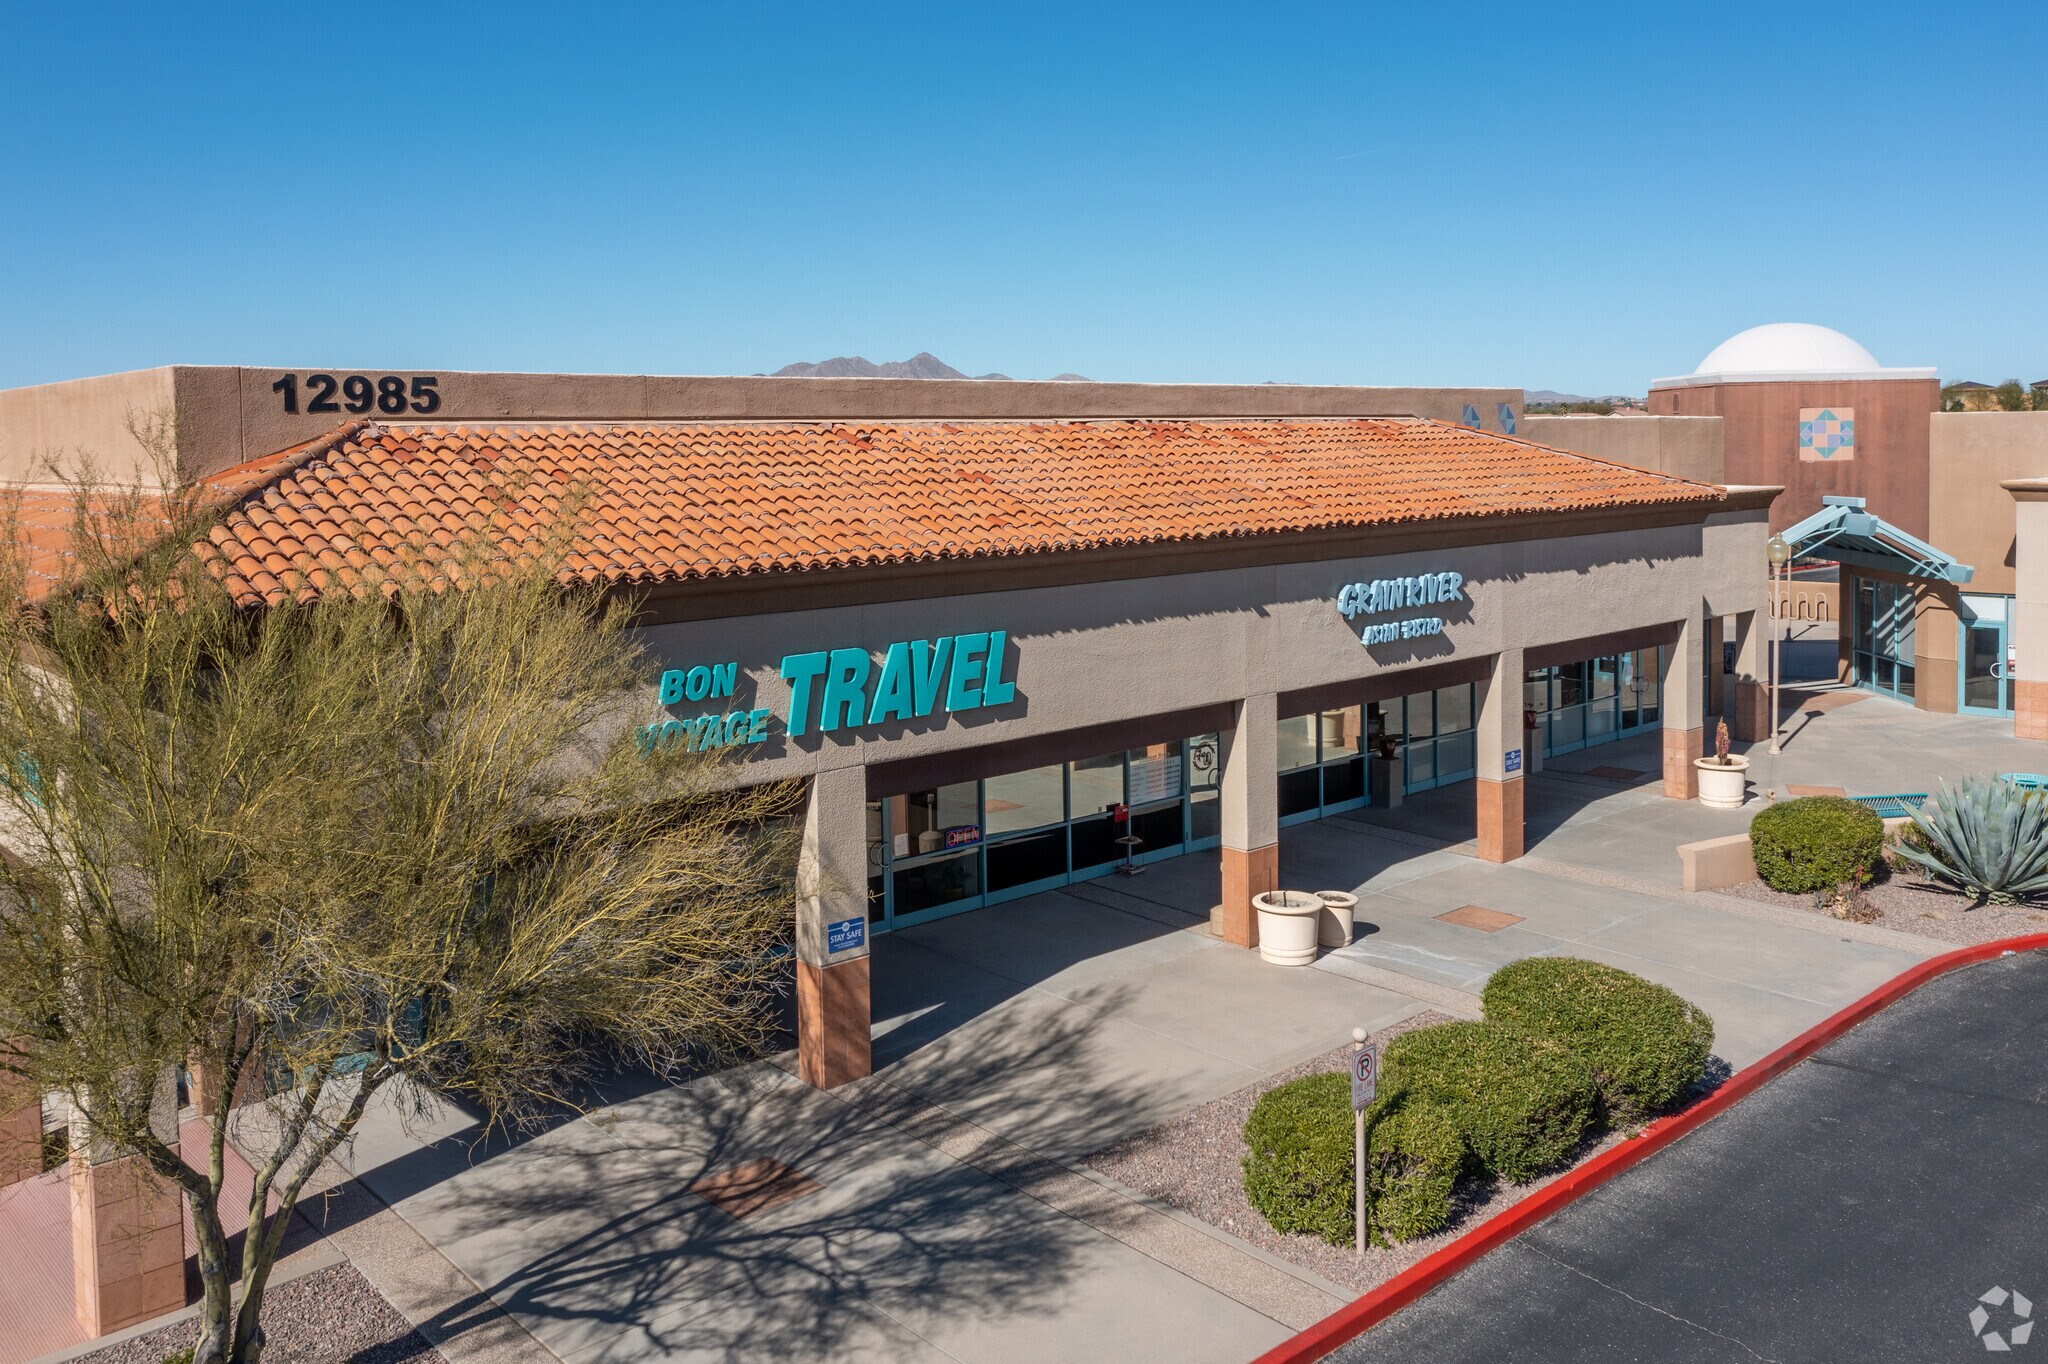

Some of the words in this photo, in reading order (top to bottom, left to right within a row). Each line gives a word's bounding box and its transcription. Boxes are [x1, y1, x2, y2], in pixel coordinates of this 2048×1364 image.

[272, 373, 440, 413] 12985
[1336, 577, 1404, 620] GRAIN
[1405, 571, 1464, 607] RIVER
[1361, 622, 1399, 646] ASIAN
[1401, 617, 1443, 639] BISTRO
[658, 662, 737, 705] BON
[780, 630, 1015, 737] TRAVEL
[635, 708, 770, 762] VOYAGE
[947, 828, 980, 846] OPEN
[830, 933, 845, 943] STAY
[846, 929, 862, 939] SAFE
